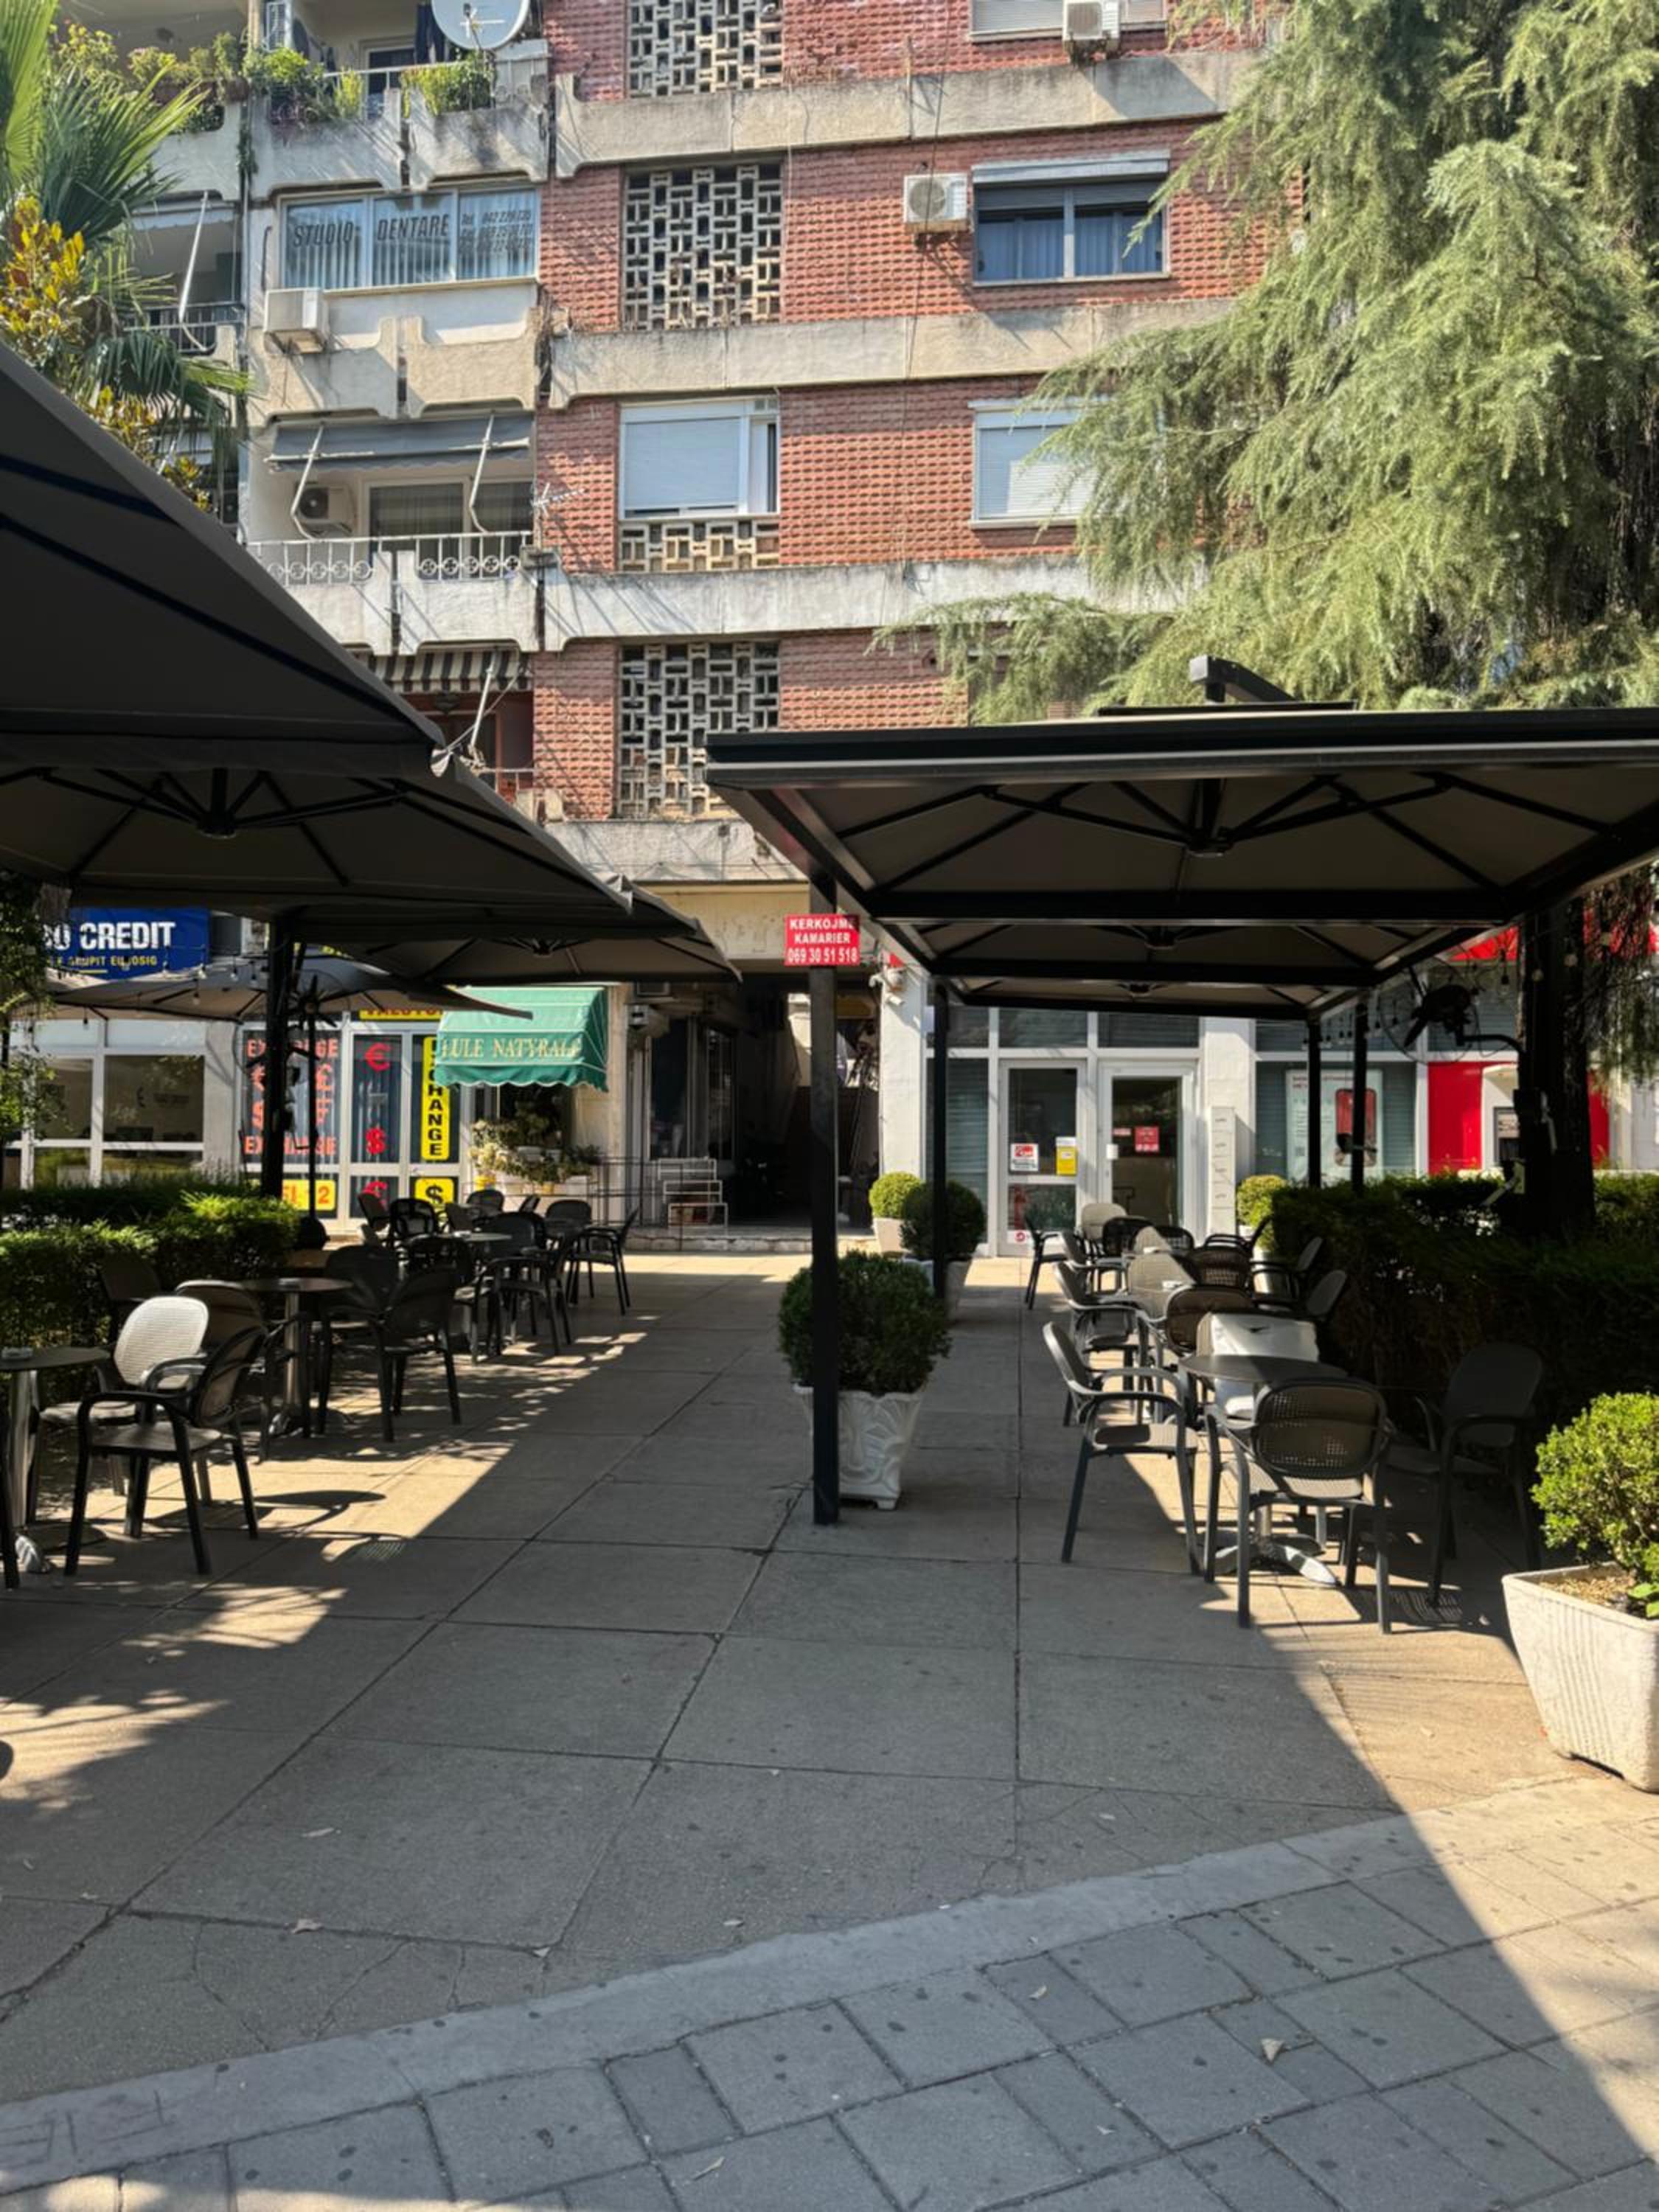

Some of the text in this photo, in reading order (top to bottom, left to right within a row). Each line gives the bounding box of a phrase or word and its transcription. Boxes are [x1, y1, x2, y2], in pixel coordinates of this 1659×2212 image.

[293, 220, 355, 248] STUDIO
[377, 214, 450, 241] DENTARE
[80, 922, 175, 950] CREDIT
[794, 933, 850, 944] KAMARIER
[787, 947, 857, 962] 069 30 51 518
